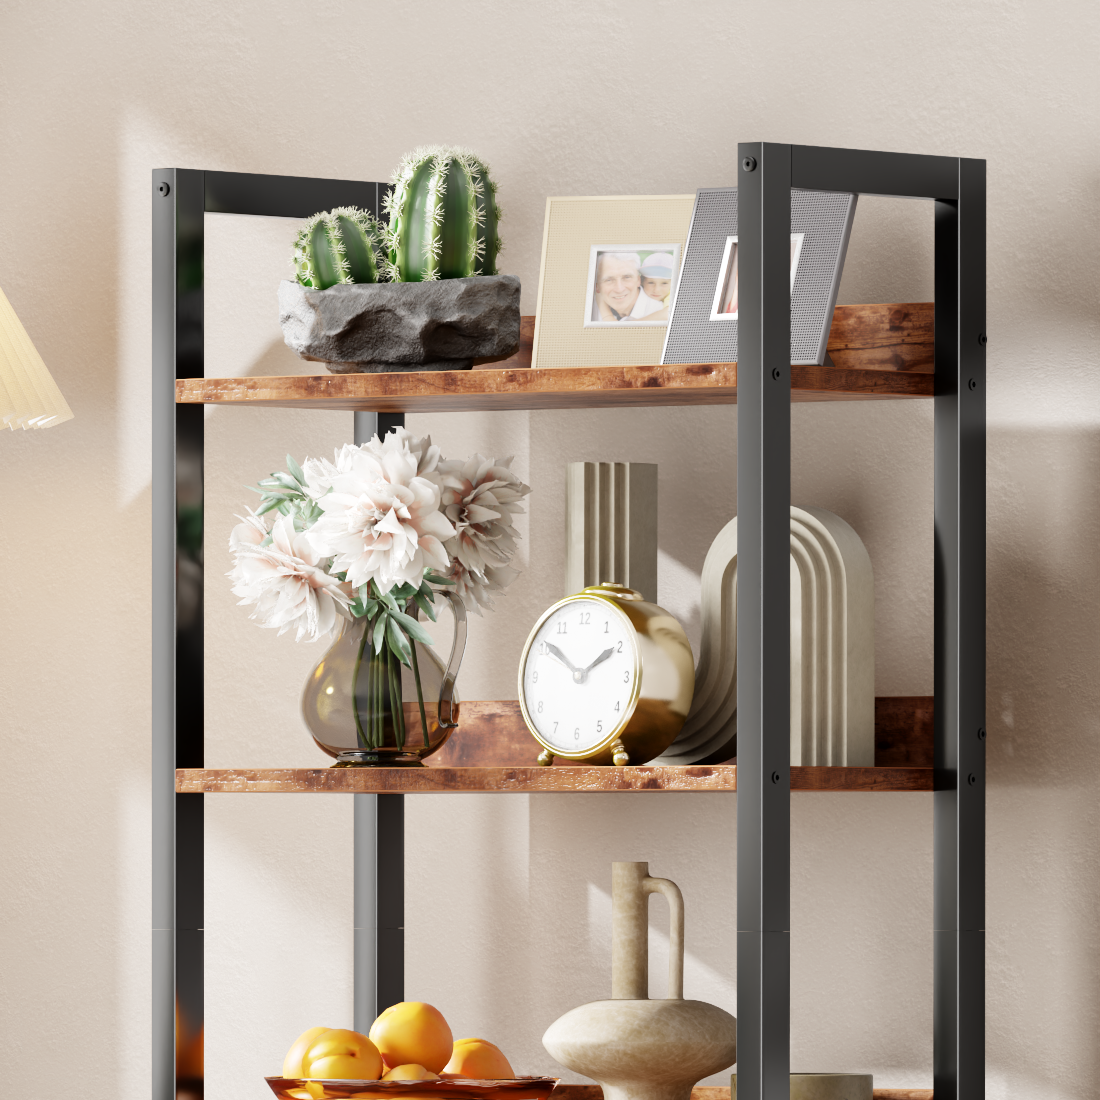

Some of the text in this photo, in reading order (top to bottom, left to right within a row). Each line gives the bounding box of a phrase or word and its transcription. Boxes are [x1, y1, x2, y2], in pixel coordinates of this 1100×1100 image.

[579, 612, 591, 625] 12
[556, 622, 568, 634] 11
[604, 621, 610, 634] 1
[617, 641, 623, 653] 2
[532, 671, 538, 683] 9
[623, 671, 630, 683] 3
[537, 701, 543, 713] 8
[614, 701, 620, 713] 4
[553, 722, 559, 734] 7
[596, 720, 603, 733] 5
[574, 728, 580, 740] 6
